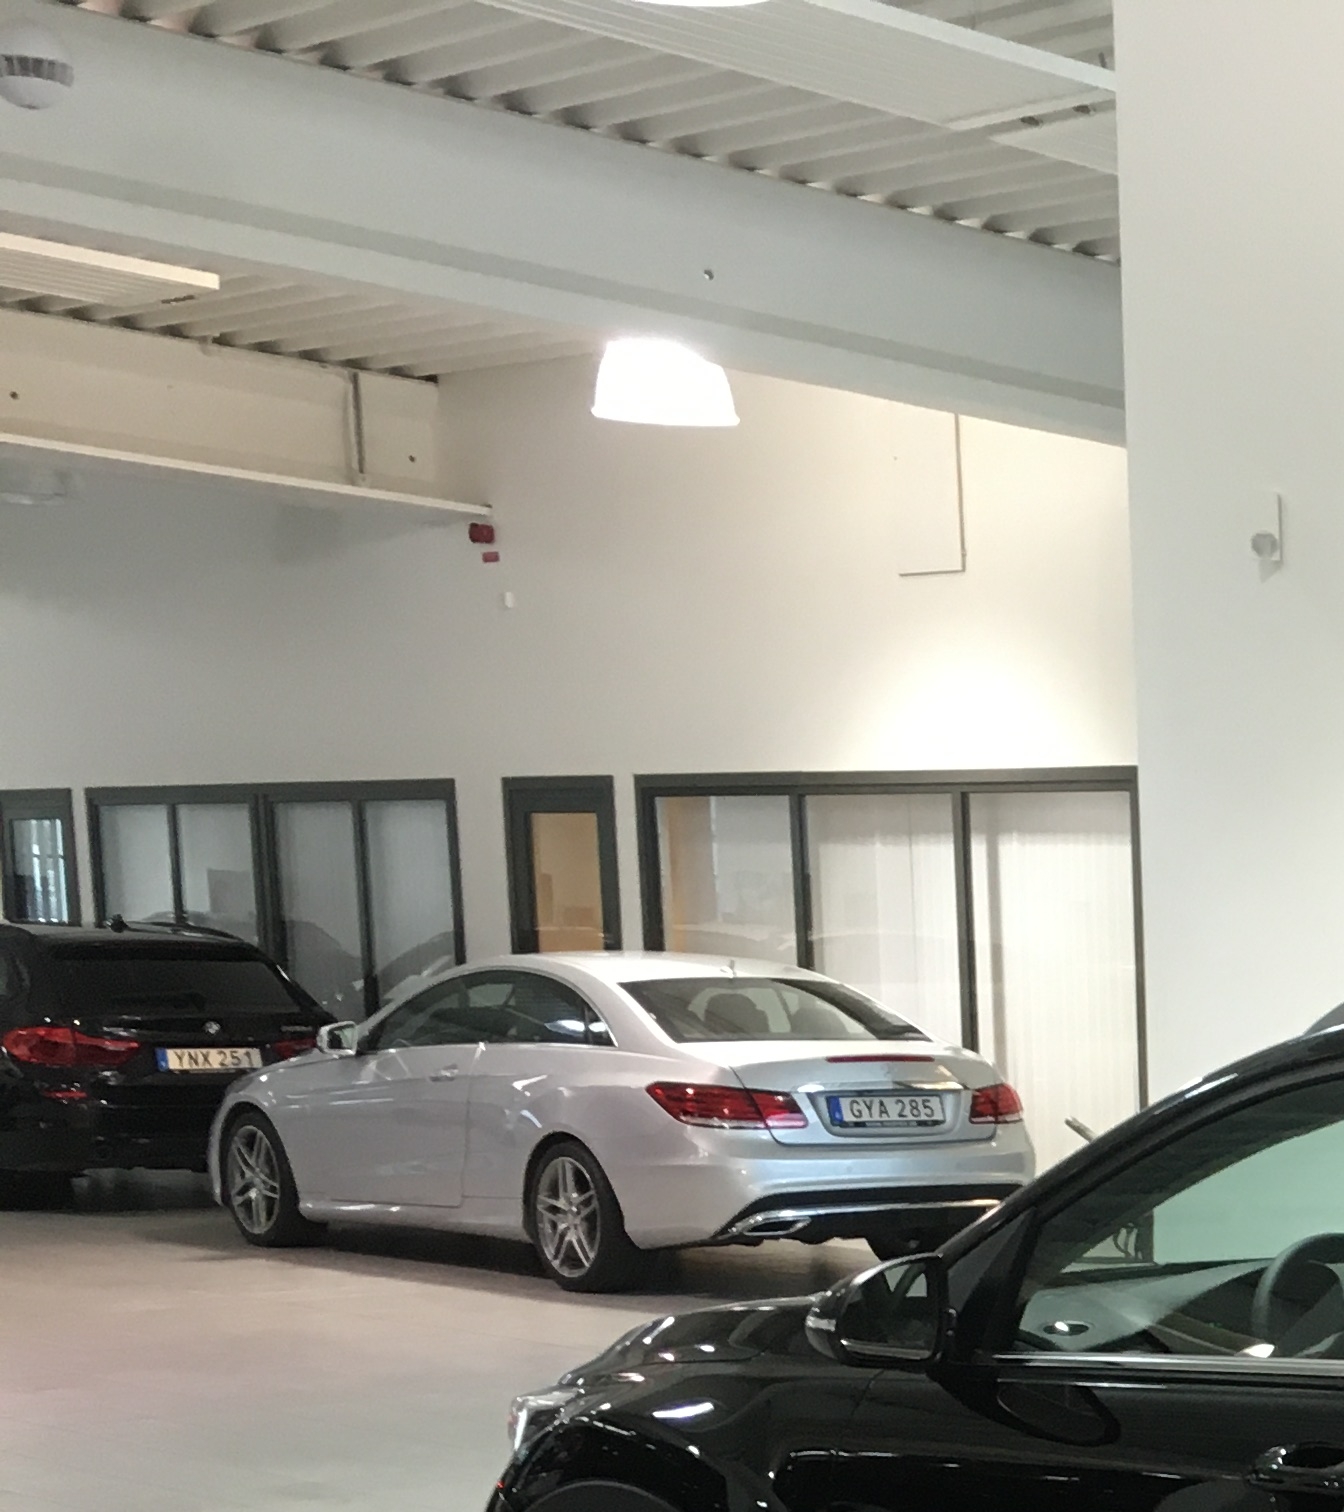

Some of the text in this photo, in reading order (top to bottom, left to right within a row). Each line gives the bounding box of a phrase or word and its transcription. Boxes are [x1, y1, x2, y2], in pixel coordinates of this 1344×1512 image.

[172, 1049, 256, 1068] YNX 251
[849, 1098, 935, 1119] GYA 285
